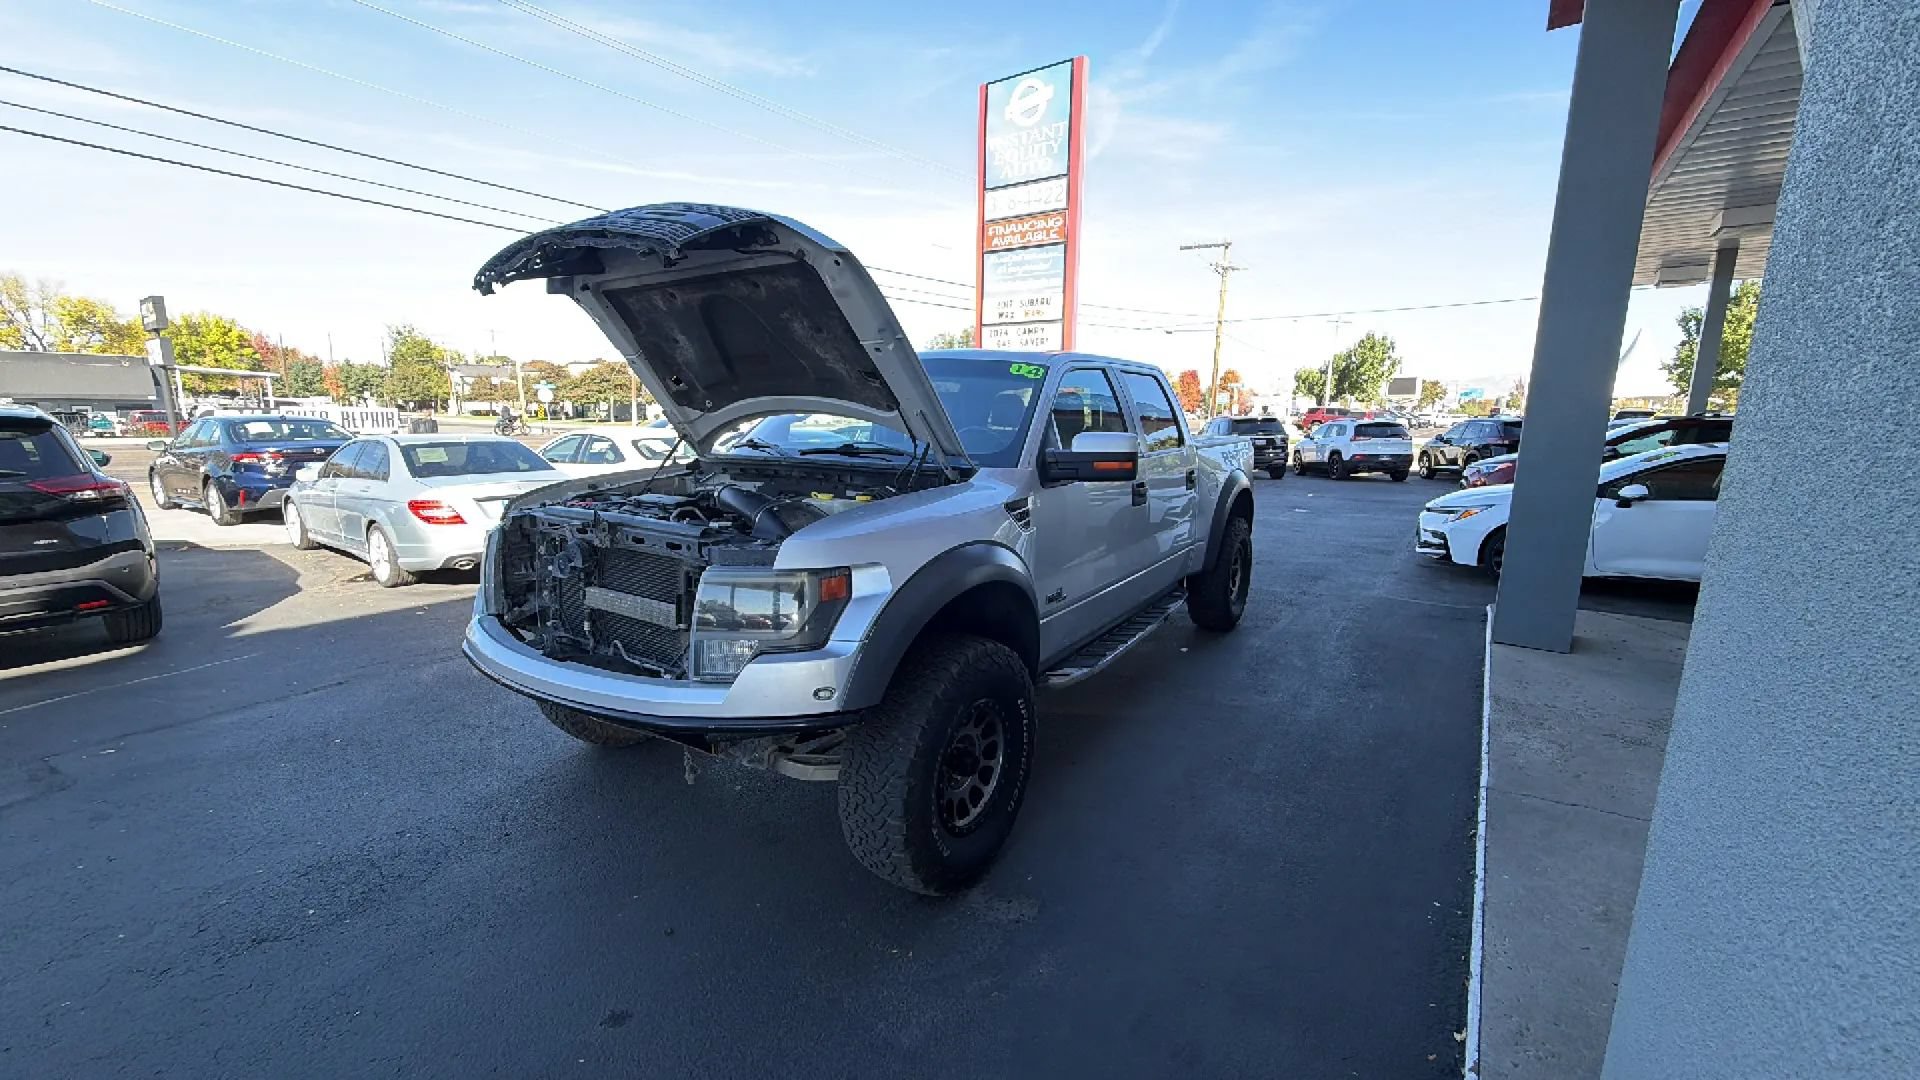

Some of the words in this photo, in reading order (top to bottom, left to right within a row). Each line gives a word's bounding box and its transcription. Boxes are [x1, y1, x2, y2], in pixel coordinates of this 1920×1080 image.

[990, 122, 1066, 149] STANT
[988, 217, 1064, 236] FINANCING
[992, 230, 1060, 246] AVAILABLE
[341, 411, 395, 429] REPAIR
